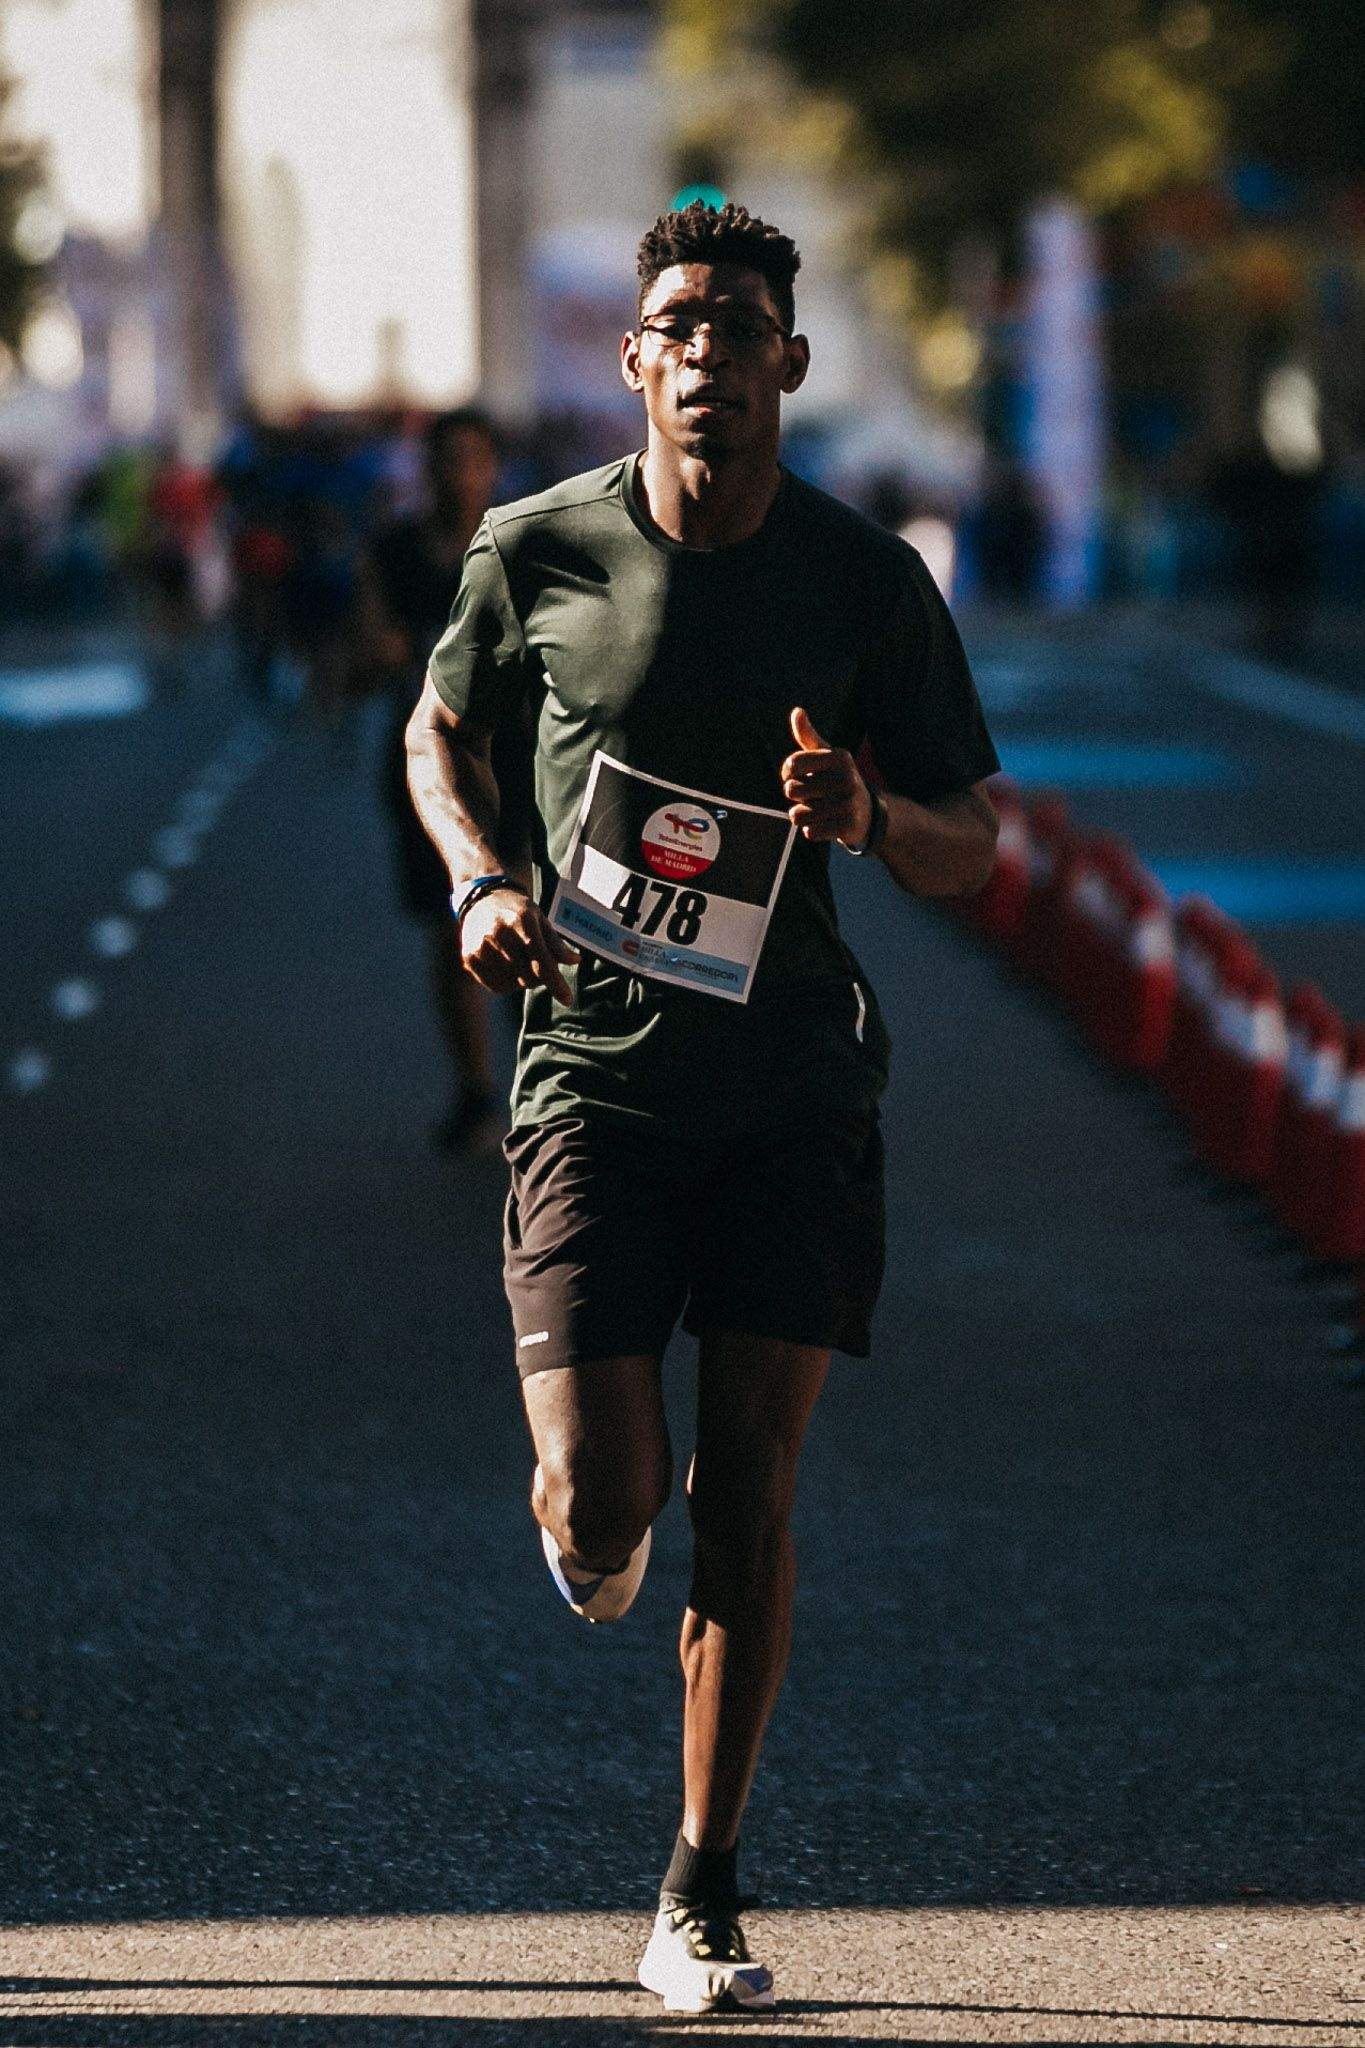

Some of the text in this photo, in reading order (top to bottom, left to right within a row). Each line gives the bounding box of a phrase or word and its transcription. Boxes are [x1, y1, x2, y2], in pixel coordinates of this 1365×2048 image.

[658, 834, 703, 852] TotalEnergies
[664, 850, 689, 863] MILLA
[665, 859, 697, 873] MADRID
[612, 873, 708, 946] 478
